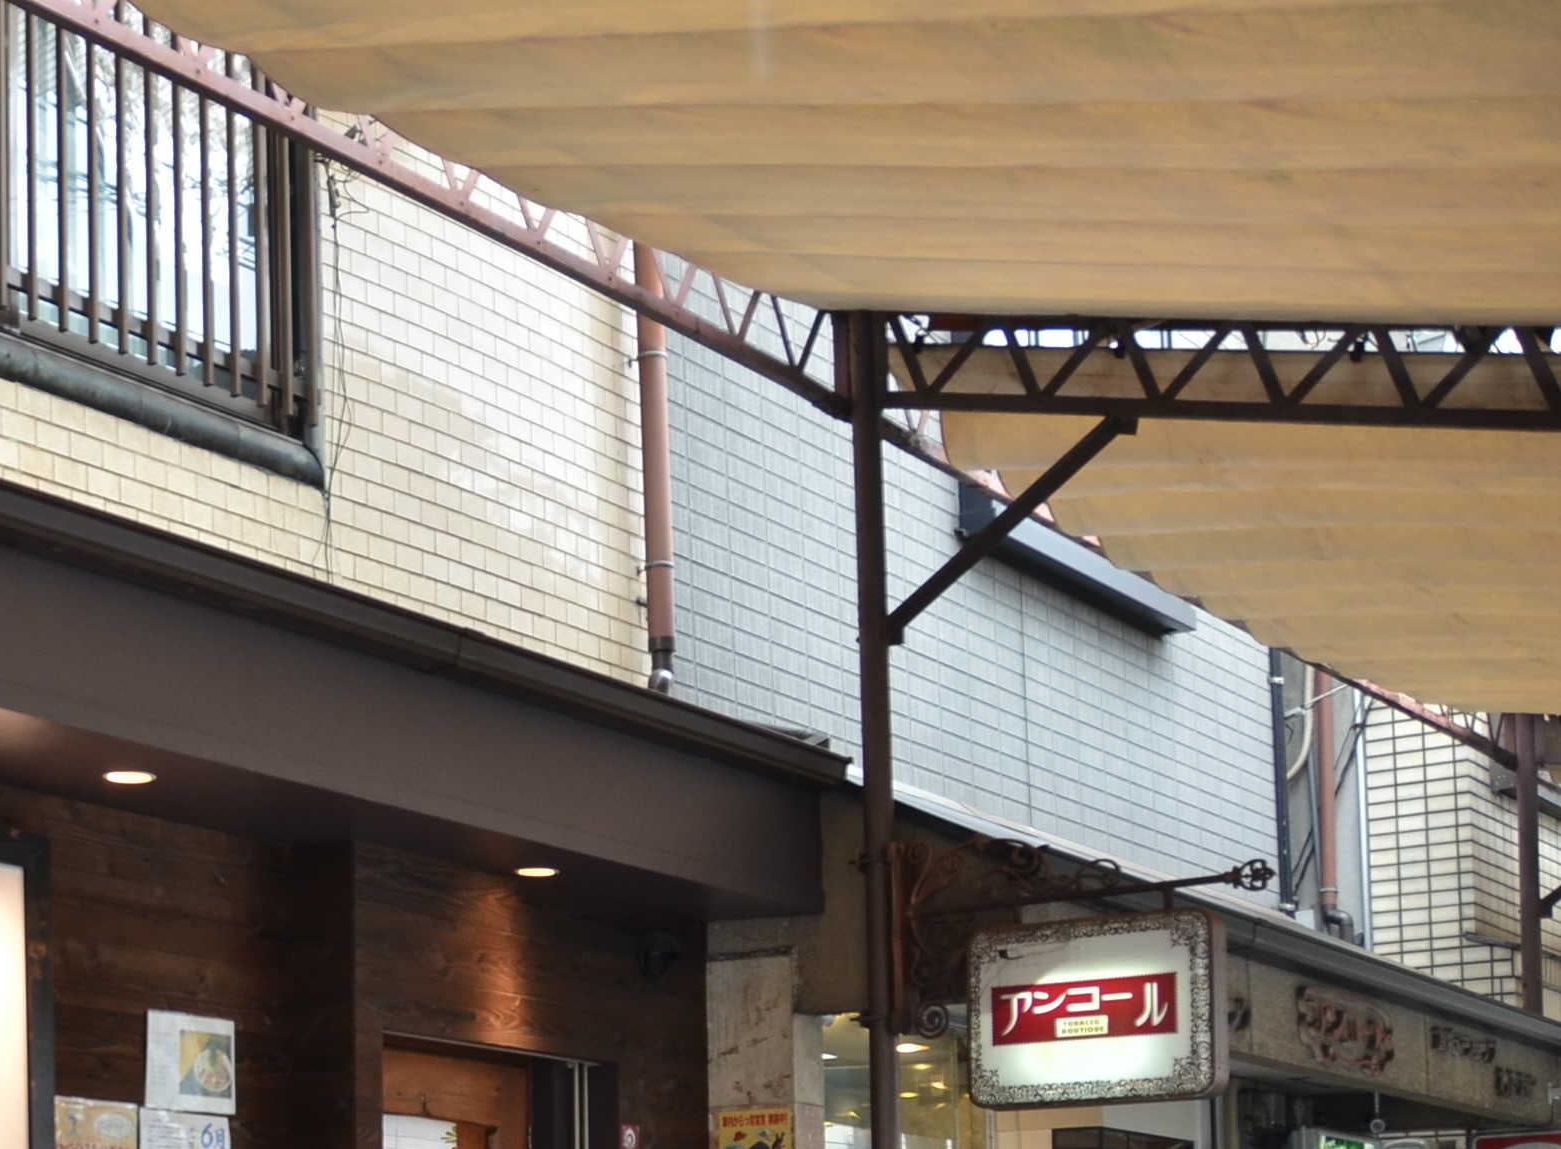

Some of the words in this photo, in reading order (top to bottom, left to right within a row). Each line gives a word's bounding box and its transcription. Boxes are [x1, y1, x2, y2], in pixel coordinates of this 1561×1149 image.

[1001, 982, 1168, 1036] アンコール
[1061, 1026, 1105, 1034] BOUTIQUE
[1063, 1019, 1101, 1027] TOBACCO
[200, 1123, 226, 1149] 6月
